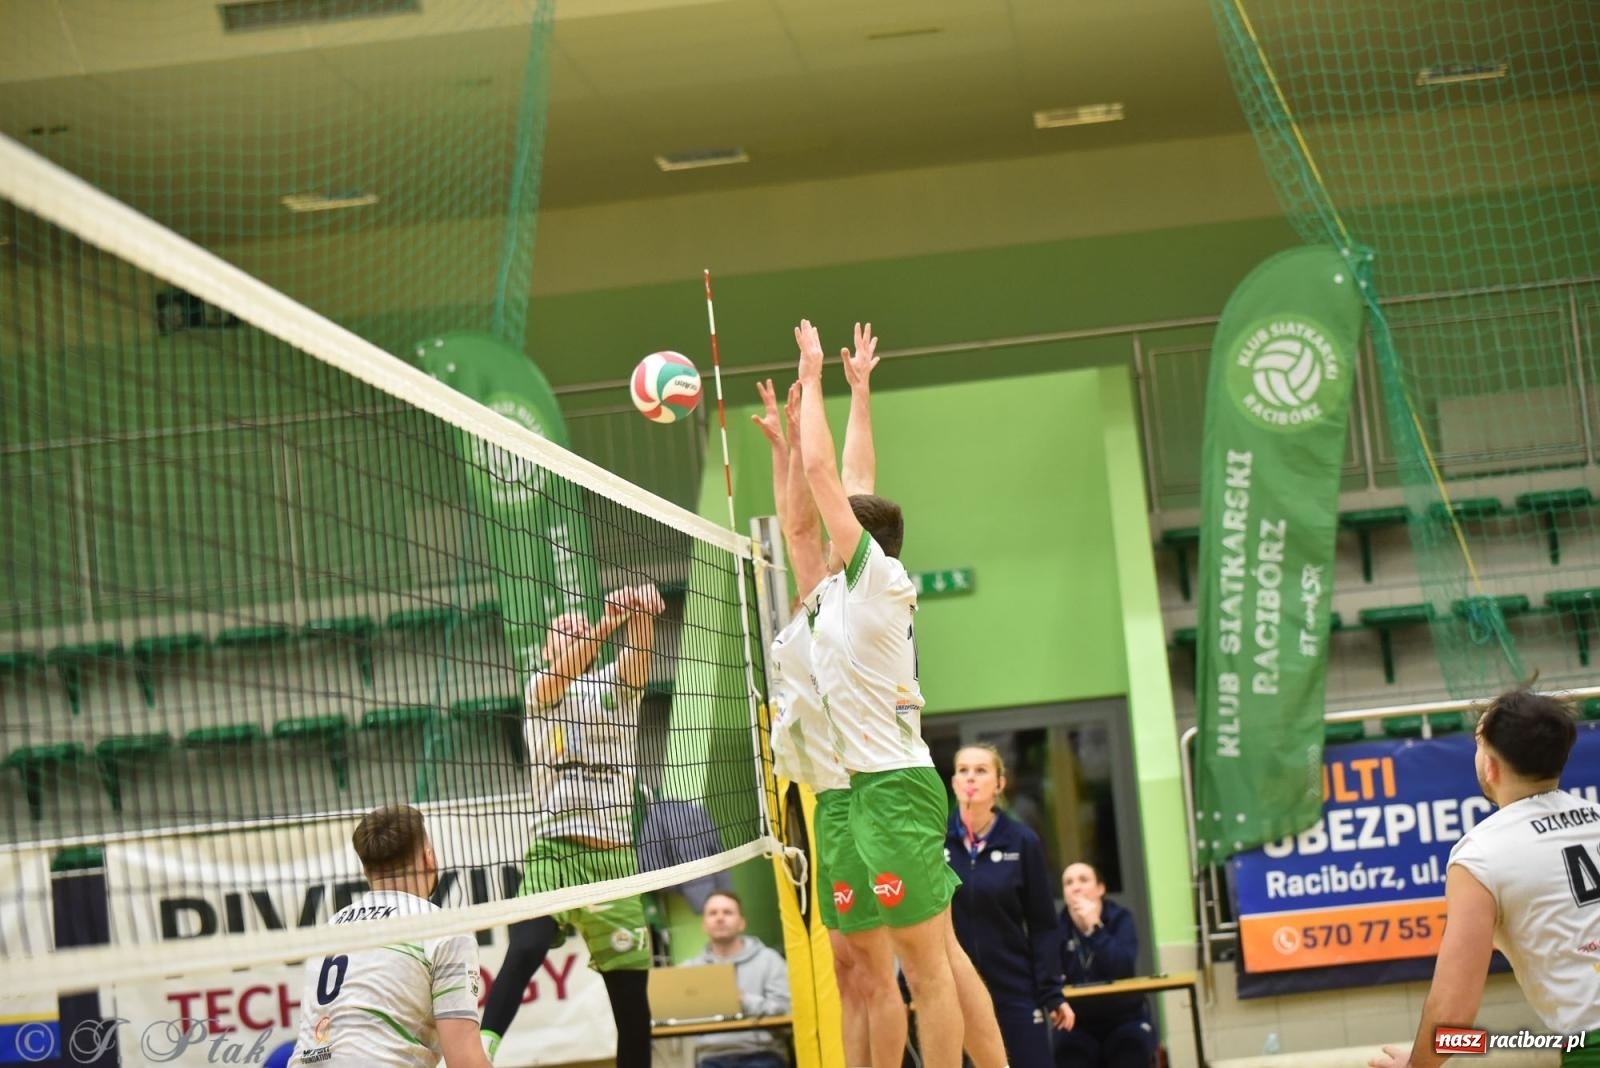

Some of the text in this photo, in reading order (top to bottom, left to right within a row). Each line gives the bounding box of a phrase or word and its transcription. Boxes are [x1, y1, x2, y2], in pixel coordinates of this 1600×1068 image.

[1216, 449, 1253, 758] KLUB SIATKARSKI
[1251, 518, 1287, 695] RACIBÓRZ
[1321, 757, 1397, 804] LTI
[1530, 806, 1600, 834] DZIADEK
[1265, 855, 1447, 899] Racibórz, ul.
[1302, 923, 1352, 949] 570
[1360, 919, 1391, 944] 77
[1398, 916, 1432, 941] 55
